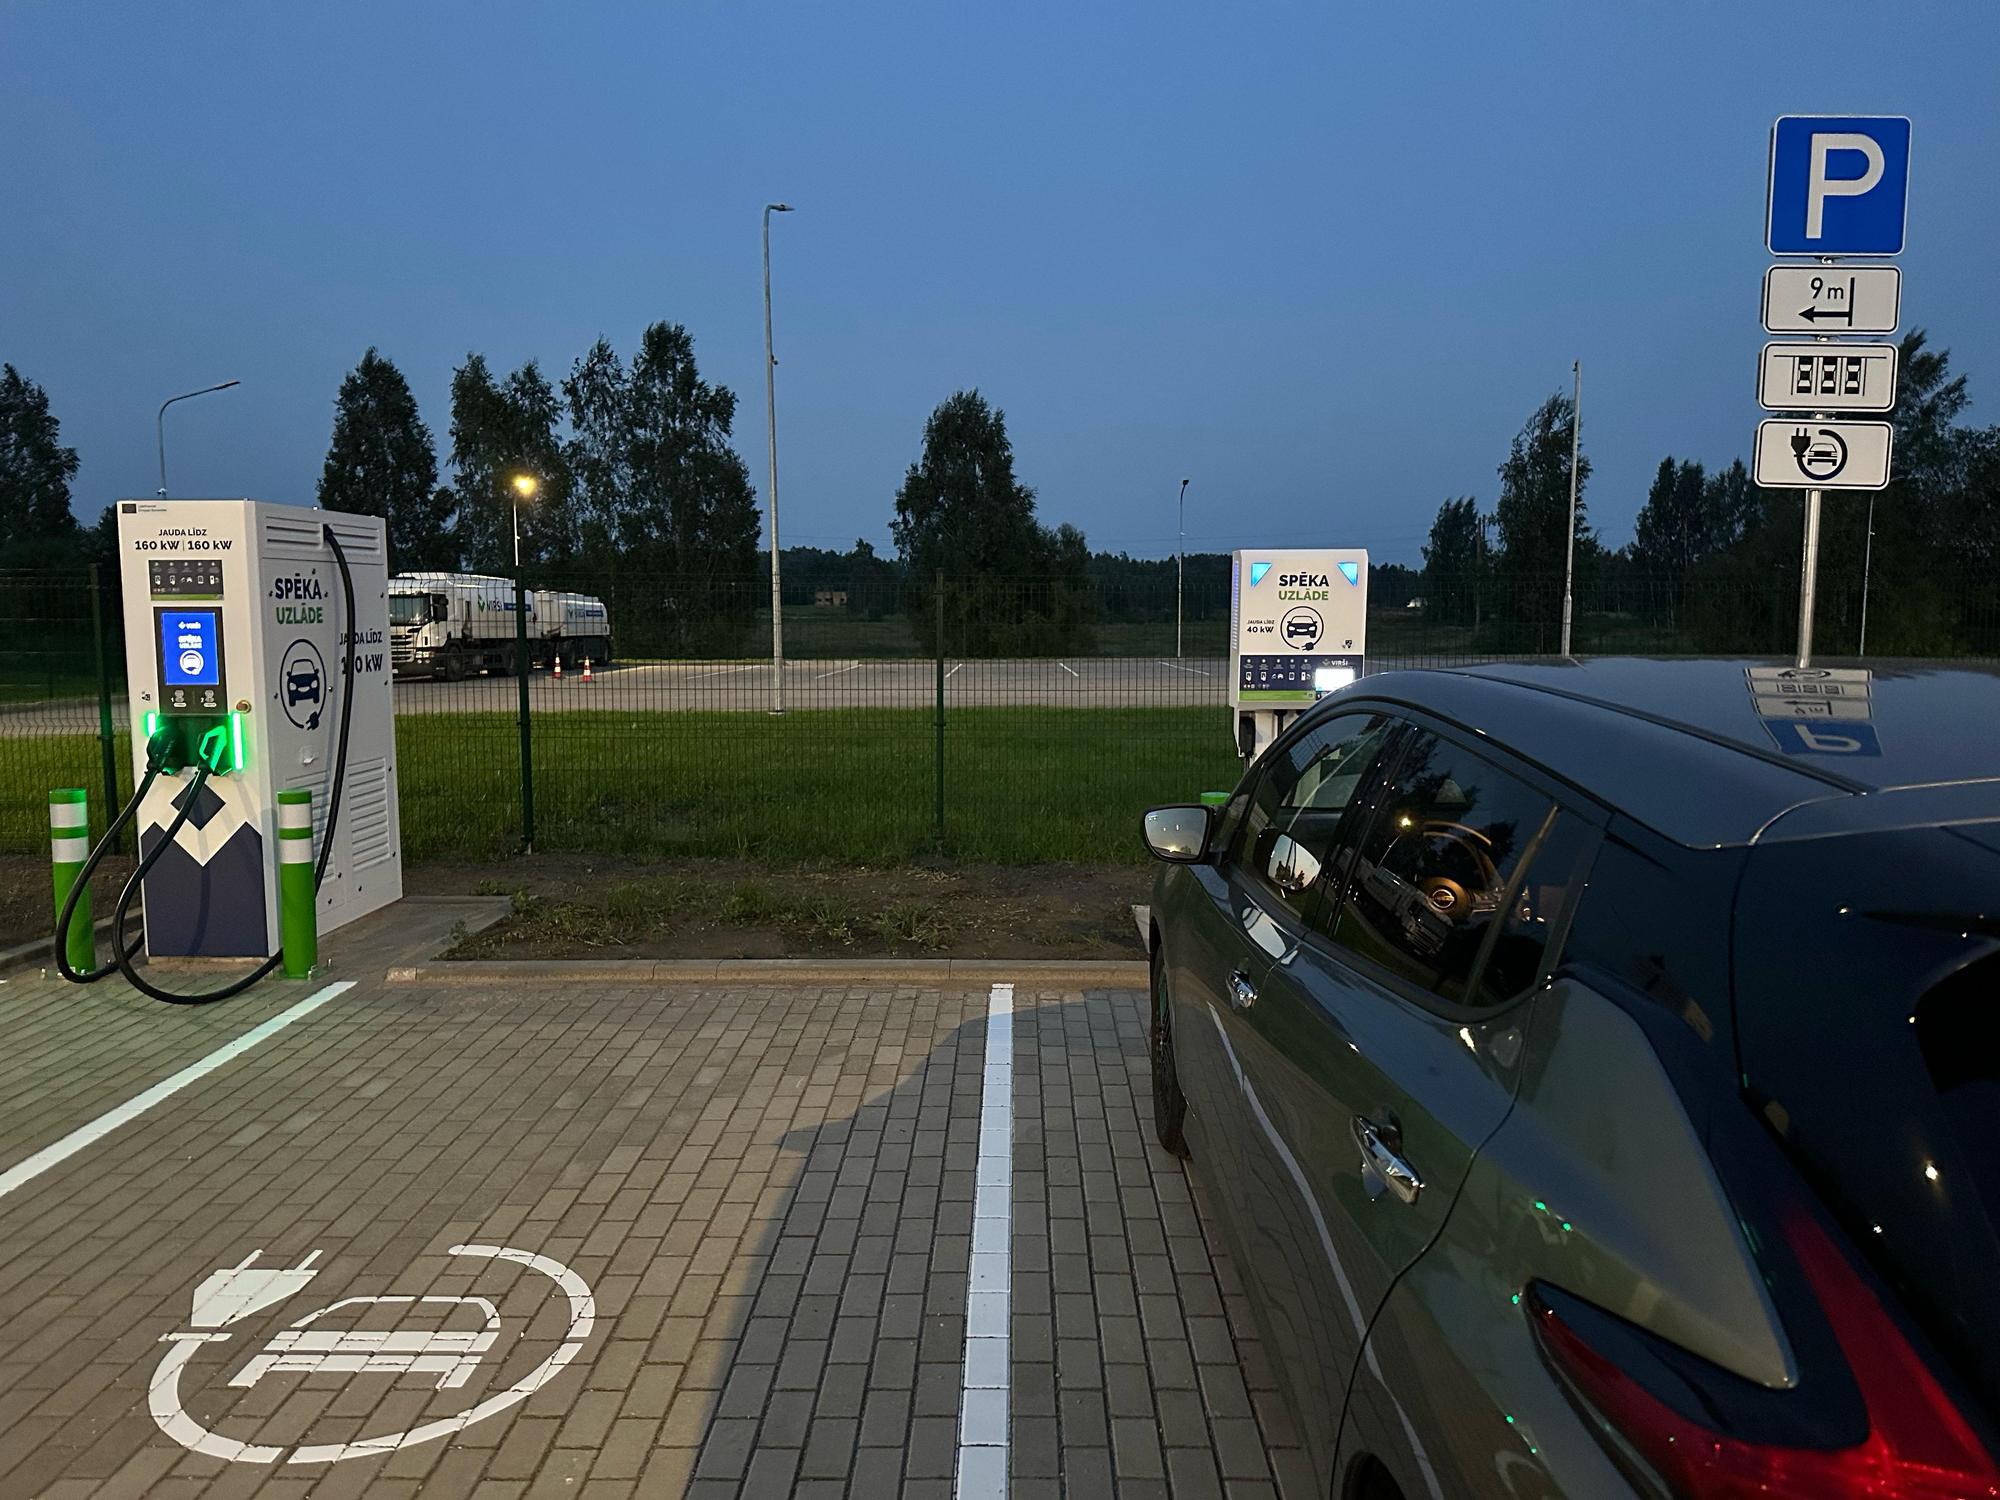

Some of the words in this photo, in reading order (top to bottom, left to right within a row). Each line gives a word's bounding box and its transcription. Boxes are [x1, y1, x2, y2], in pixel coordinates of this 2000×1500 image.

[1806, 134, 1885, 239] P
[1811, 277, 1823, 299] 9
[1827, 287, 1844, 299] m
[158, 528, 186, 536] JAUDA
[188, 527, 207, 536] LĪDZ
[135, 541, 157, 550] 160
[160, 541, 180, 550] kW
[187, 541, 210, 550] 160
[213, 541, 232, 550] kW
[275, 573, 322, 599] SPĒKA
[1279, 572, 1329, 586] SPĒKA
[1279, 588, 1329, 600] UZLĀDE
[276, 602, 323, 624] UZLĀDE
[340, 632, 365, 645] JADA
[366, 628, 382, 643] LĪDZ
[341, 656, 363, 674] 10
[365, 654, 383, 672] kW
